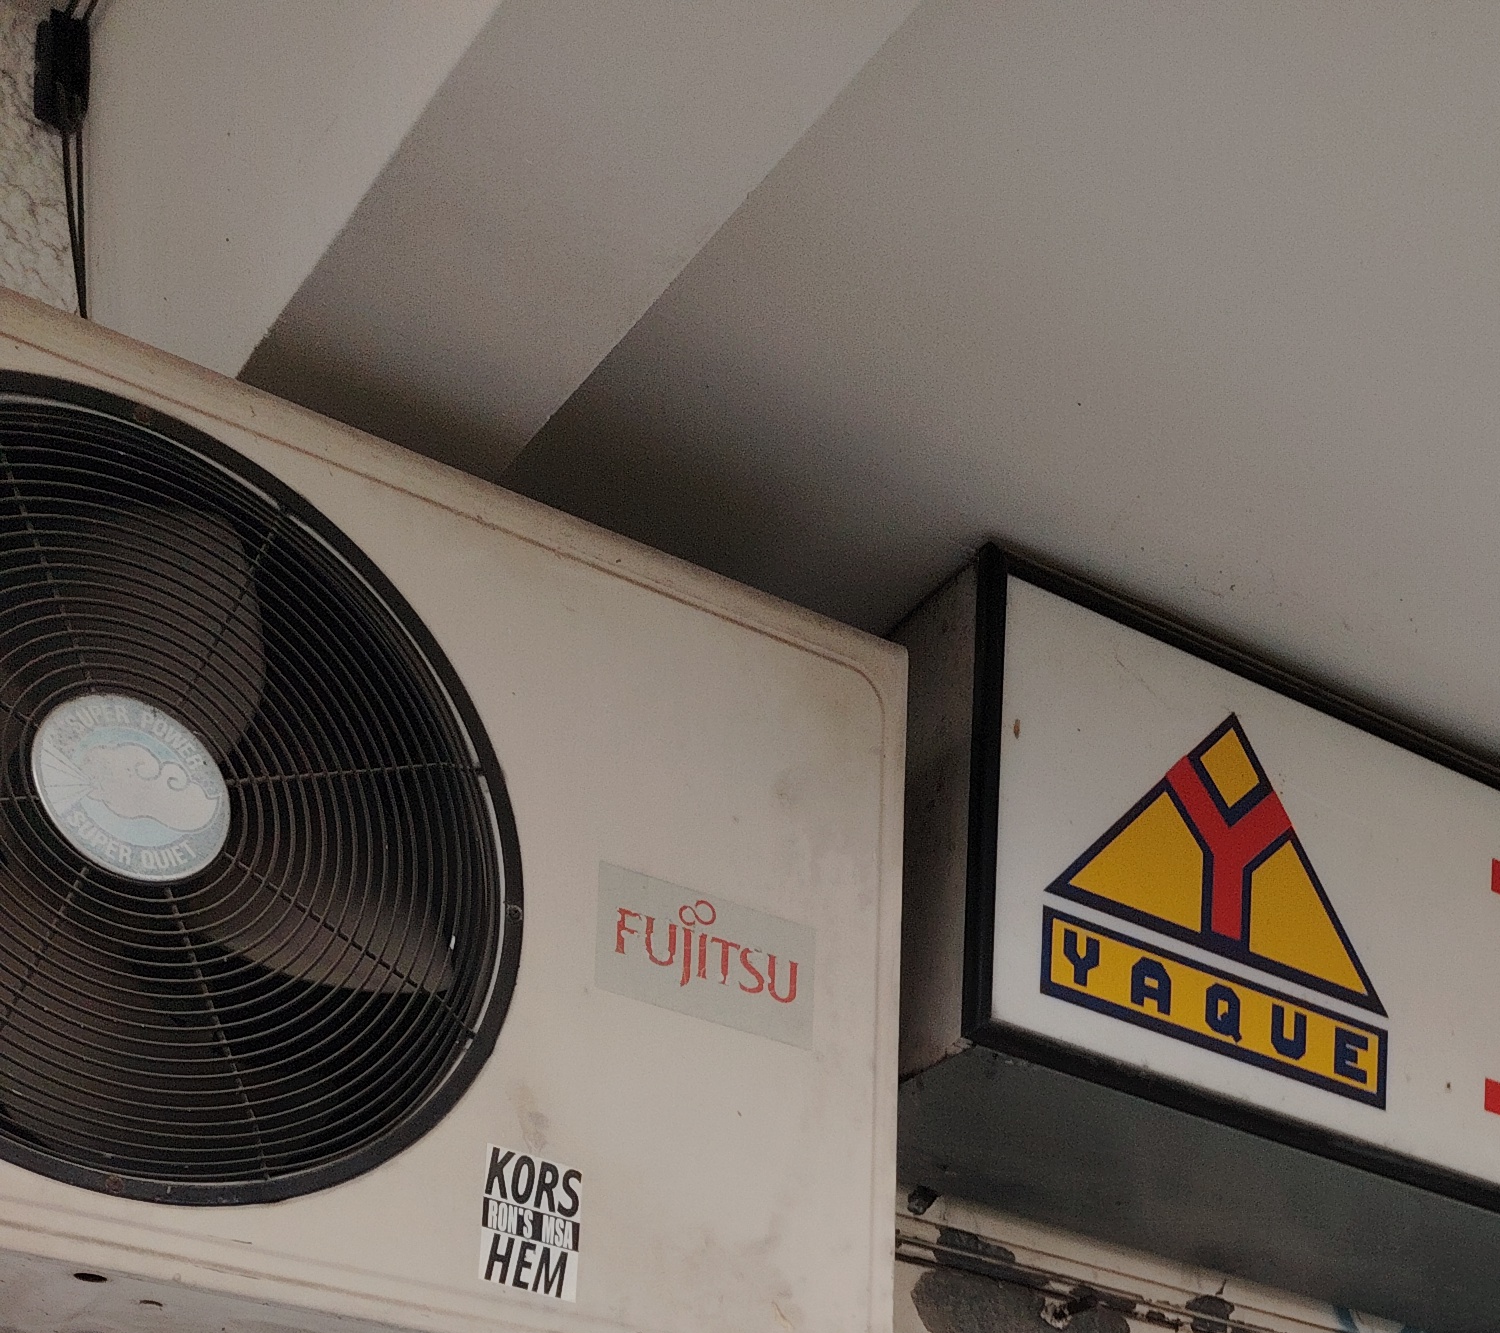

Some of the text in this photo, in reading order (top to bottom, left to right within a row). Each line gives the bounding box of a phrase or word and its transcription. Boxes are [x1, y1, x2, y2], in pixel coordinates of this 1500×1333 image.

[66, 705, 131, 731] SUPER
[67, 810, 198, 869] SUPER QUIET
[615, 902, 800, 1004] FUJITSU
[1062, 925, 1370, 1084] YAQUE
[485, 1146, 583, 1218] KORS
[486, 1202, 574, 1250] RON'S MSA
[484, 1233, 568, 1299] HEM
